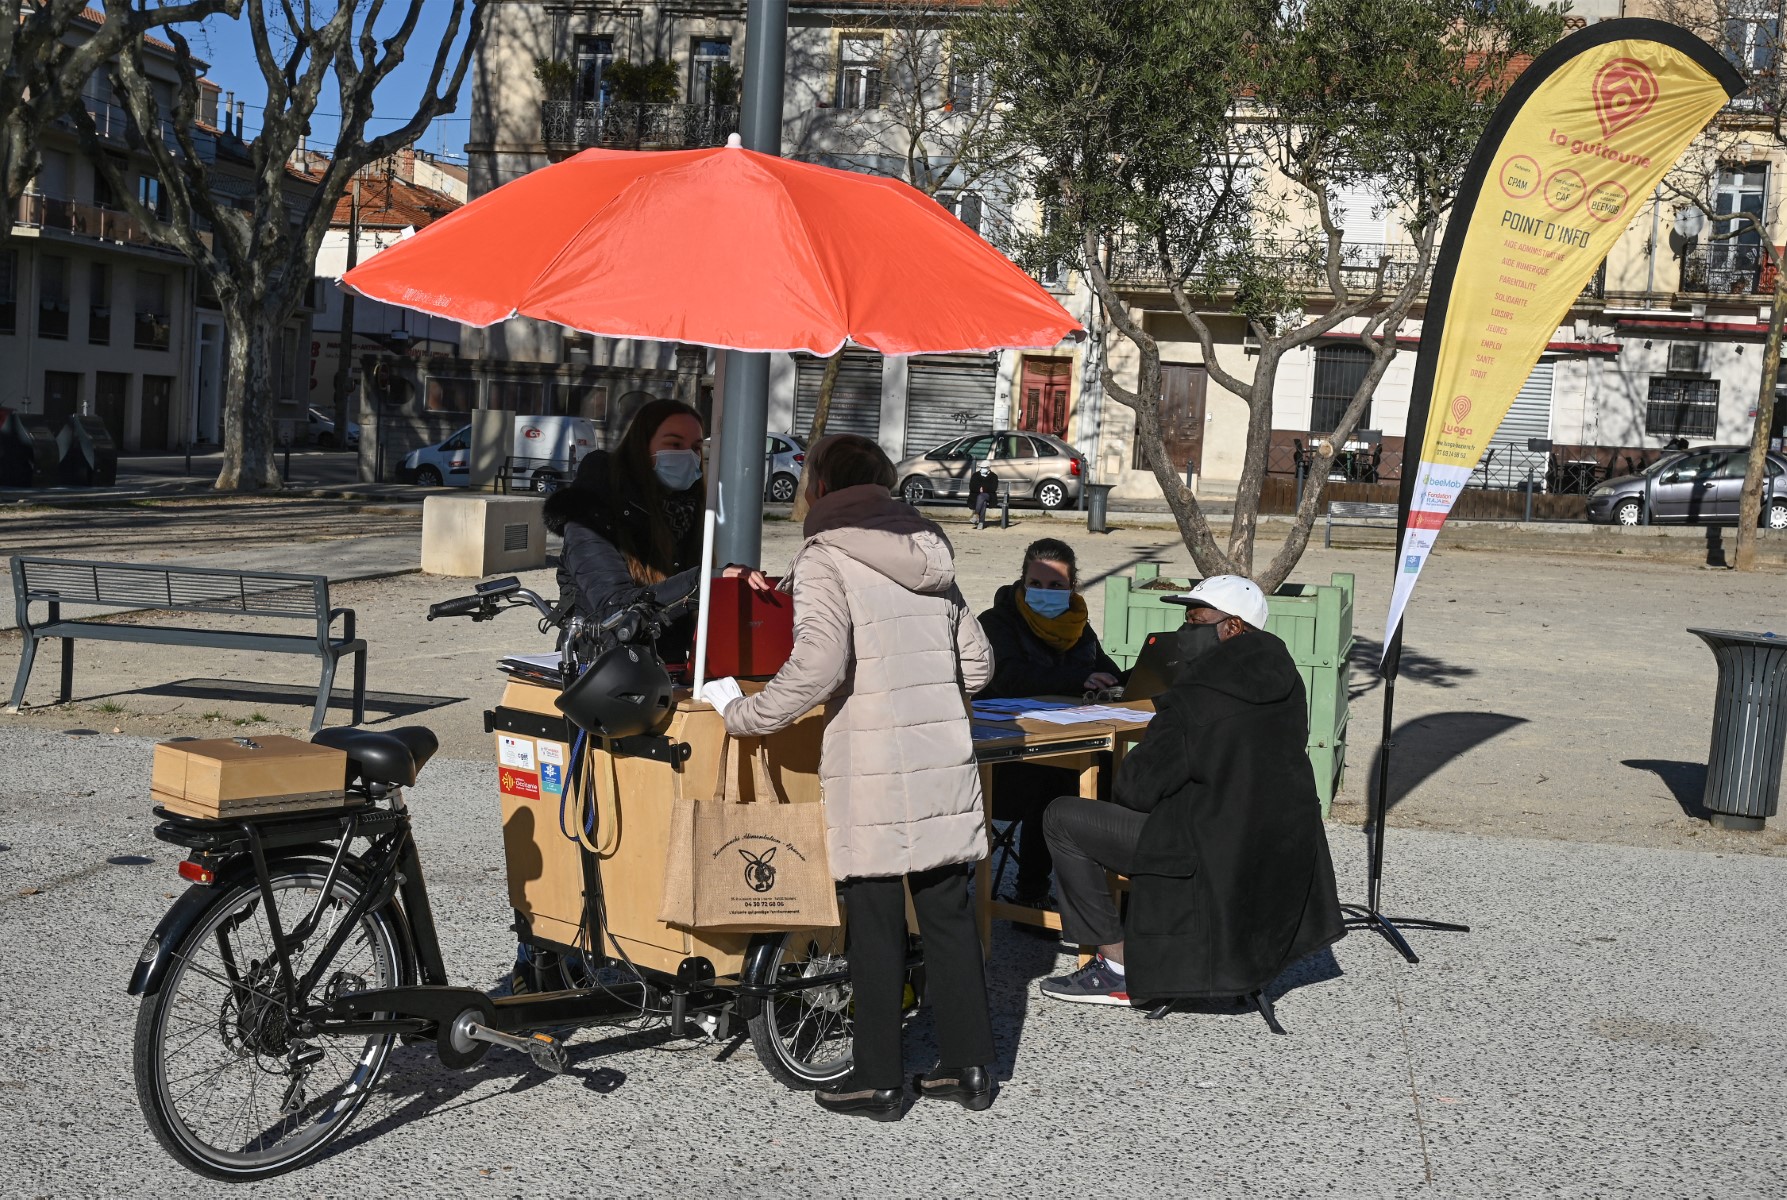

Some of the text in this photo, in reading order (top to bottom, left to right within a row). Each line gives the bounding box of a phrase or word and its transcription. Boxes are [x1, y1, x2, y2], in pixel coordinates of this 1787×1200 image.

[1549, 128, 1652, 169] la guitoune
[1507, 176, 1529, 190] CPAM
[1555, 191, 1571, 203] CAF
[1501, 210, 1591, 248] POINT D'INFO
[1504, 240, 1566, 262] AIDE ADMINISTRATIVE
[1501, 257, 1515, 268] AIDE
[1499, 274, 1537, 292] PARENTALITE
[1494, 292, 1528, 307] SOLIDARITE
[1491, 308, 1514, 320] LOISIRS
[1486, 323, 1508, 336] JEUNES
[1481, 339, 1503, 351] EMPLOI
[1475, 354, 1495, 365] SANTE
[1470, 369, 1488, 379] DROIT
[1441, 421, 1473, 437] Luoga
[1429, 478, 1461, 489] beeMob
[1427, 491, 1452, 500] Fondation
[515, 780, 538, 790] Occitanie
